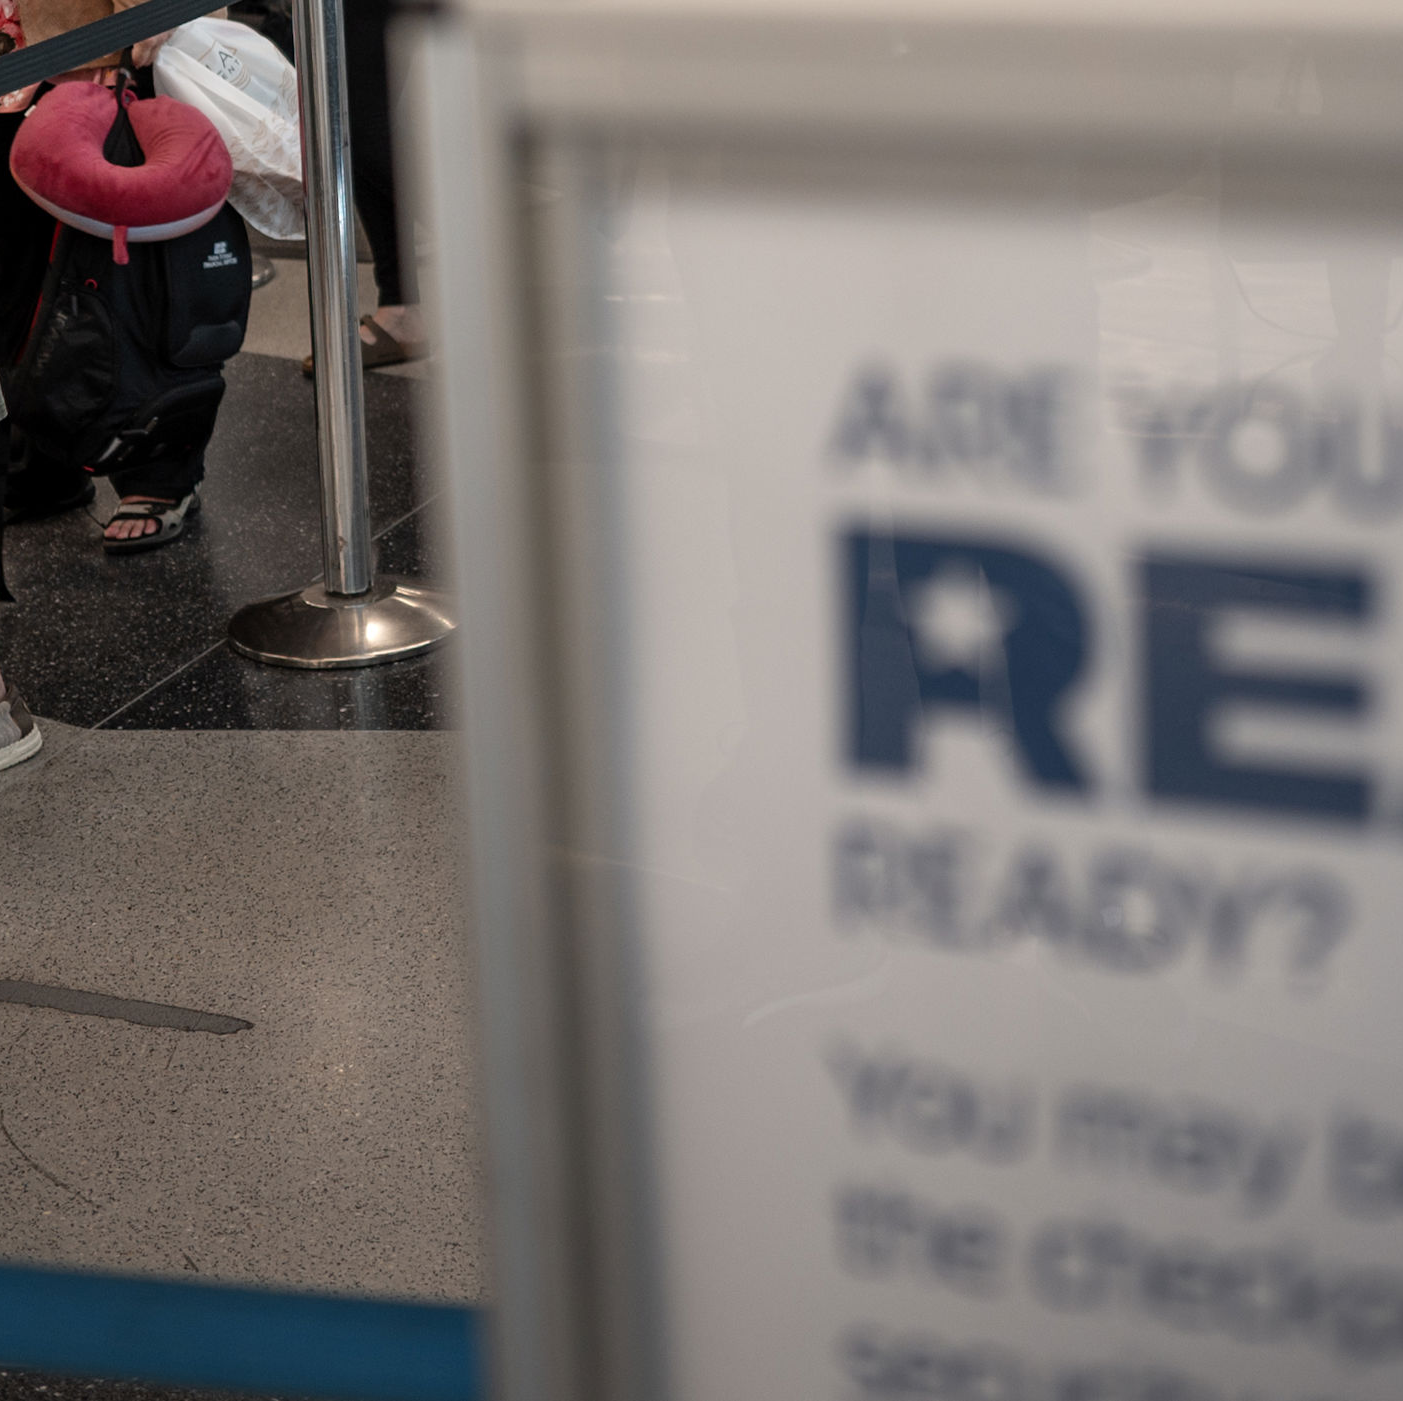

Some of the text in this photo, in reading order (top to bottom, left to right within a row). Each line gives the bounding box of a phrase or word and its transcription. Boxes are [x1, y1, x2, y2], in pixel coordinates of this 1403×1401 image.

[832, 363, 1072, 493] ARE
[834, 817, 1354, 993] READY?
[829, 1037, 1033, 1164] You
[1053, 1083, 1308, 1218] may
[834, 1183, 1003, 1298] the
